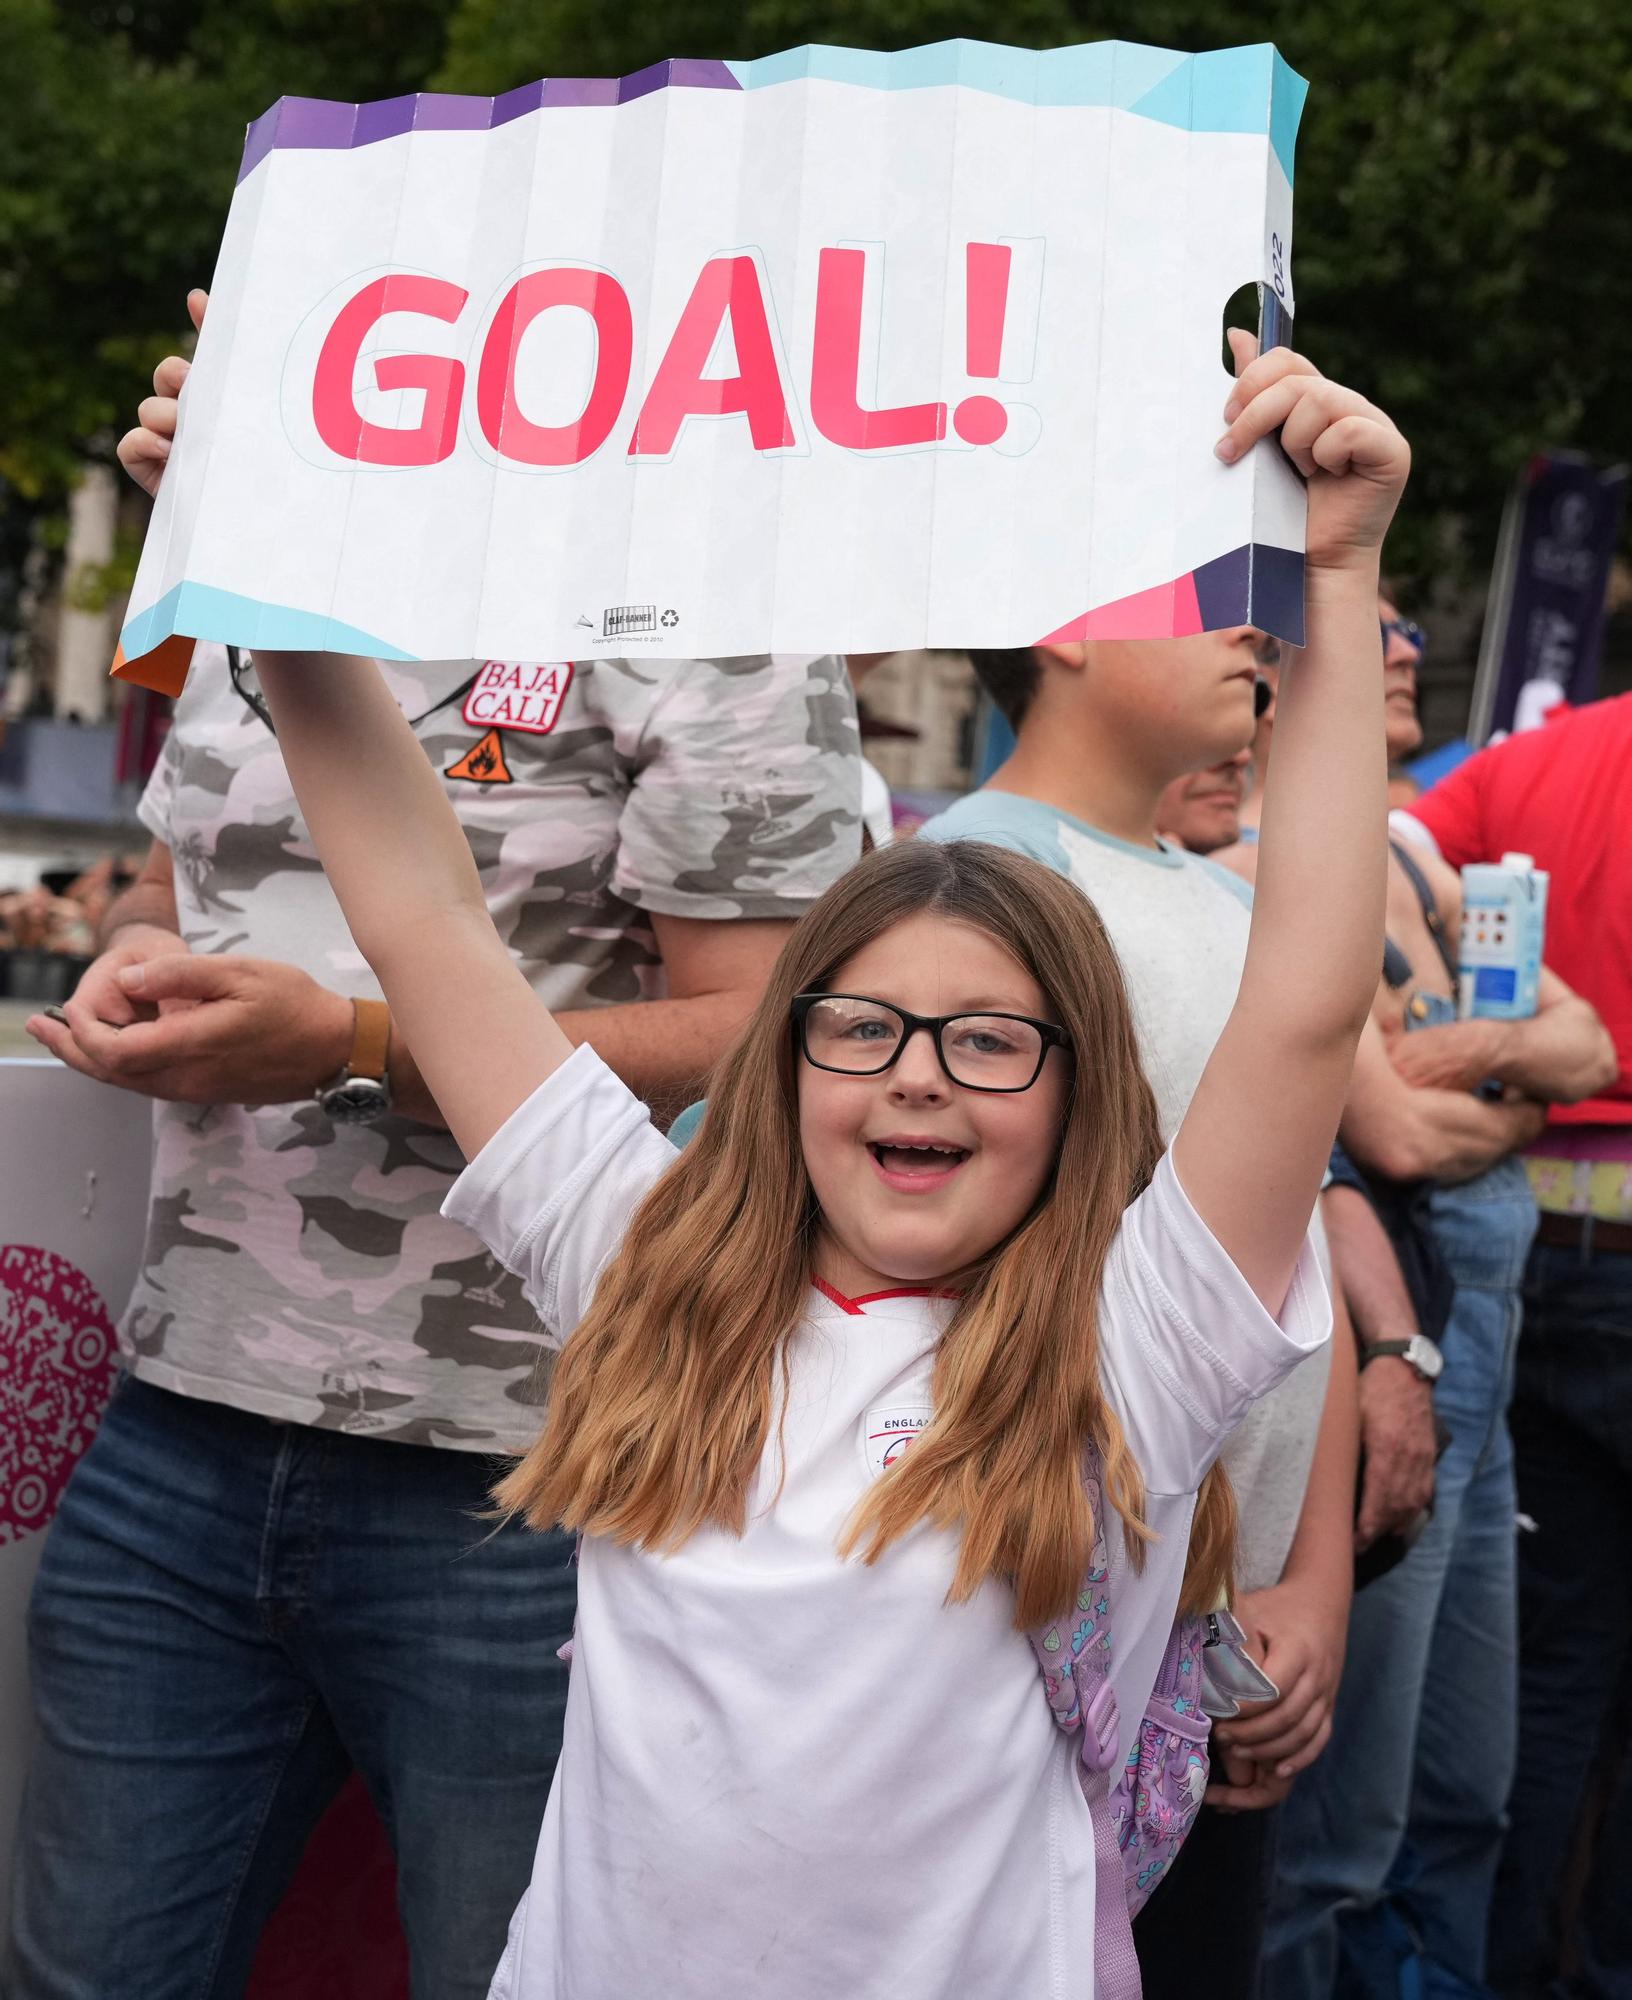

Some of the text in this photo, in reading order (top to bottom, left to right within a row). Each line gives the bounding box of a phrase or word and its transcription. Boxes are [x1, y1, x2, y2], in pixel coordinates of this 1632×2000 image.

[312, 241, 1012, 466] GOAL!
[592, 637, 616, 645] Copyright
[482, 663, 558, 694] BAJA
[472, 691, 552, 727] CALI
